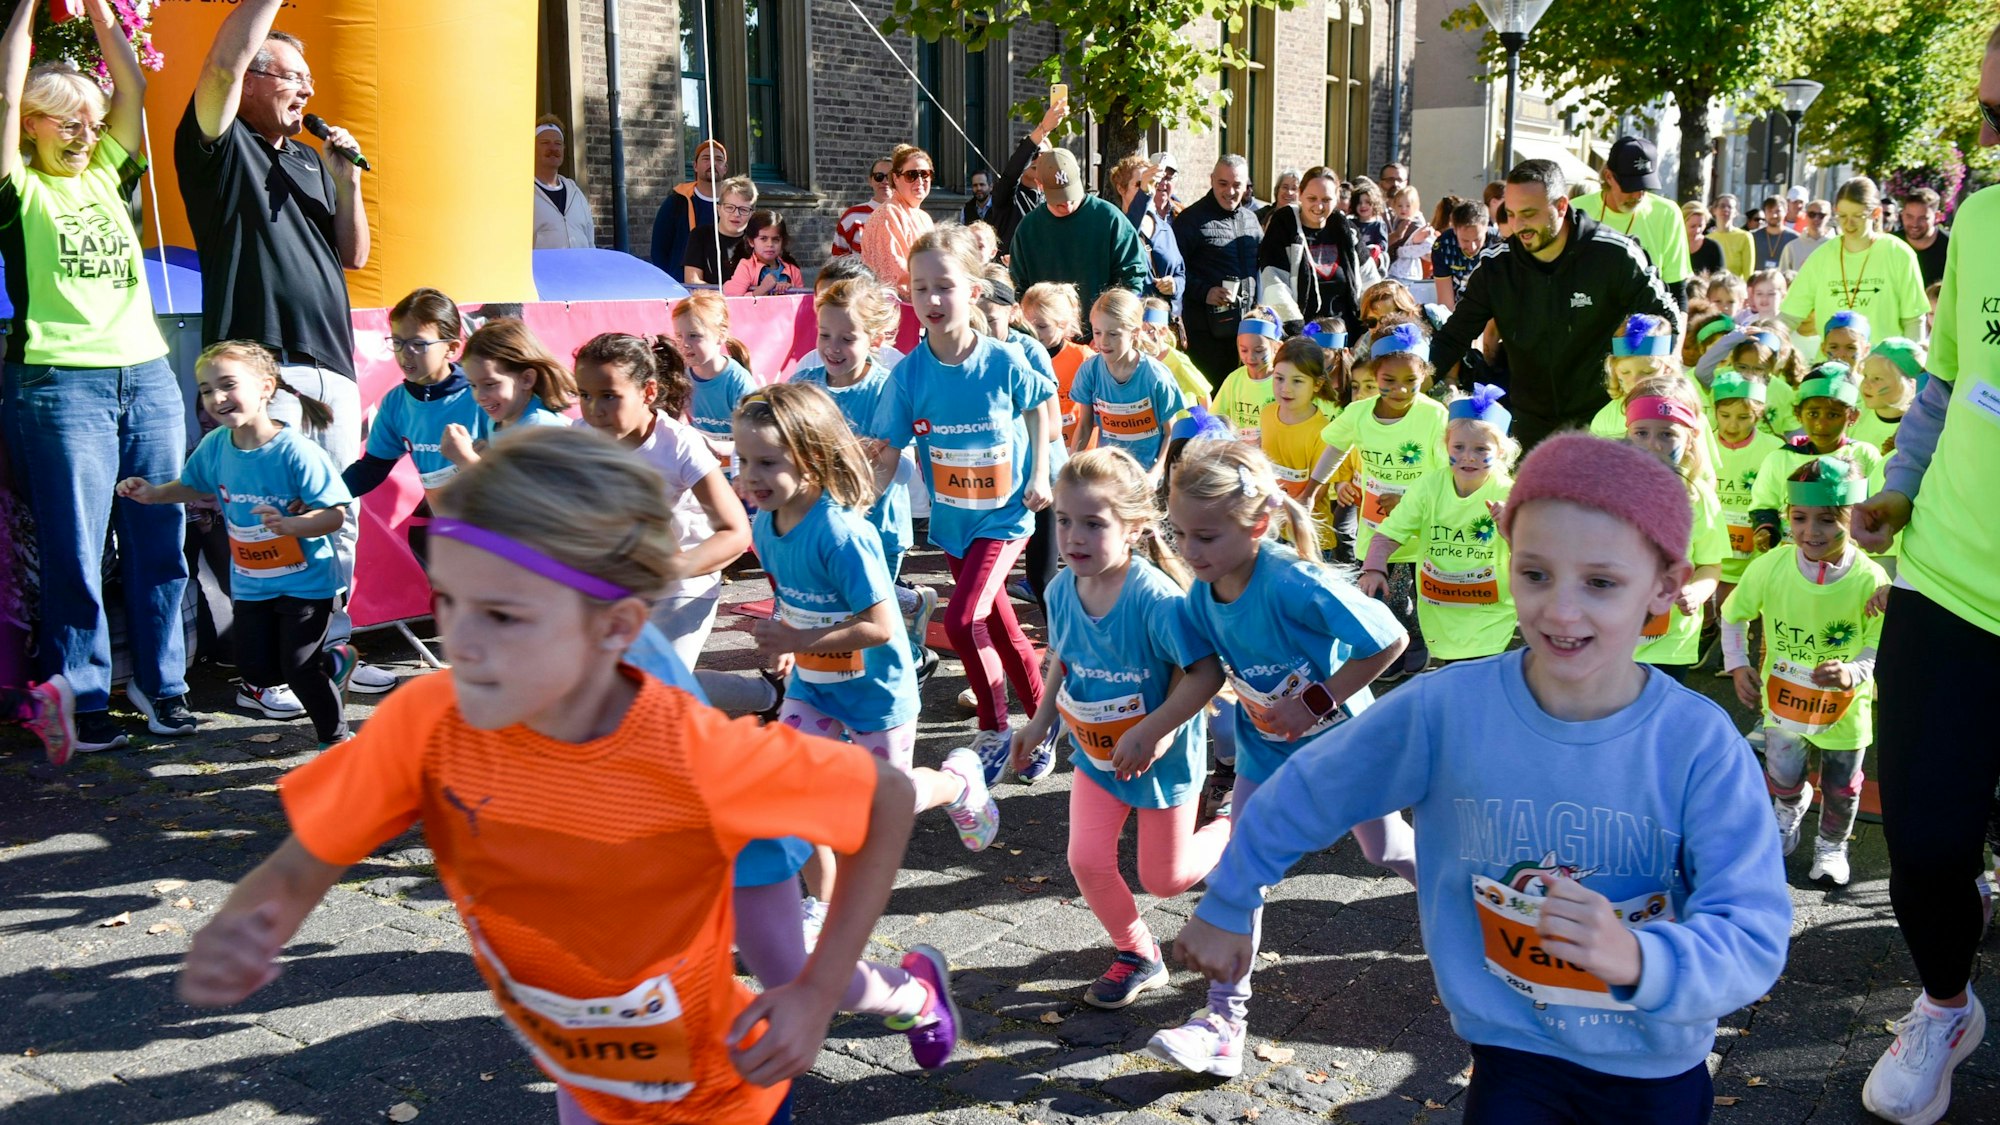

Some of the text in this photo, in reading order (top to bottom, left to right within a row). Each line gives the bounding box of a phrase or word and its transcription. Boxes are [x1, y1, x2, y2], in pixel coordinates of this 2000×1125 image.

[59, 234, 129, 256] LAUF
[60, 258, 132, 278] TEAM
[1103, 416, 1151, 428] Caroline
[948, 473, 995, 489] Anna
[1430, 525, 1465, 543] ITA
[238, 546, 279, 561] Eleni
[1427, 545, 1494, 560] tarke Pänz
[1424, 580, 1492, 597] Charlotte
[1777, 688, 1838, 714] Emilia
[1075, 725, 1113, 749] Ella
